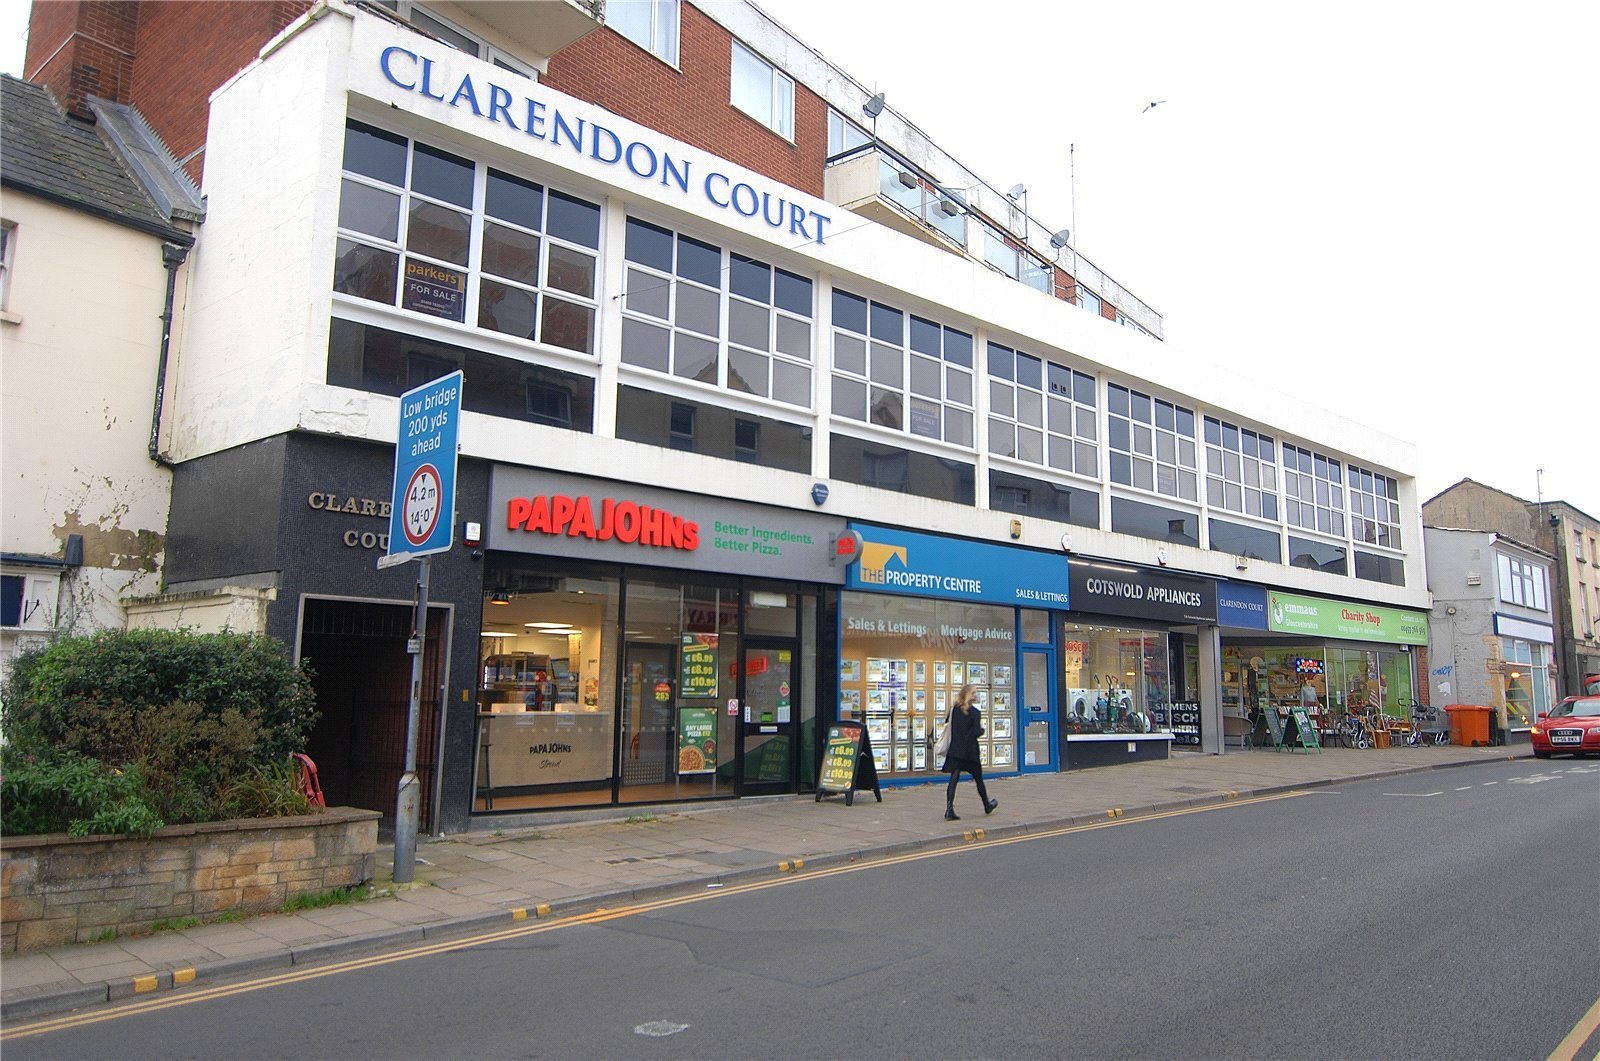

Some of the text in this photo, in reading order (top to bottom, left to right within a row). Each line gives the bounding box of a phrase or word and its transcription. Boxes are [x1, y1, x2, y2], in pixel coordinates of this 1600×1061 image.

[380, 45, 831, 246] CLARENDON COURT
[407, 263, 457, 284] parkers
[410, 283, 456, 302] FOR SALE
[403, 387, 457, 419] Low bridge
[408, 409, 448, 437] 200 yds
[411, 431, 441, 456] ahead
[410, 486, 436, 503] 4.2 m
[308, 491, 391, 518] CLARE
[508, 495, 700, 550] PAPA JOHNS
[343, 530, 389, 551] COU
[714, 521, 815, 545] Better Ingredients.
[714, 537, 783, 556] Better Pizza.
[862, 567, 982, 594] THE PROPERTY CENTRE
[1015, 588, 1068, 603] SALES & LETTINGS
[1086, 577, 1201, 607] COTSWOLD APPLIANCES
[1219, 598, 1264, 612] CLARENDON COURT
[1285, 602, 1318, 617] emmaus
[848, 617, 927, 637] Sales & Lettings
[1341, 608, 1381, 627] Charity Shop
[940, 623, 1013, 641] Mortgage Advice
[691, 651, 714, 663] £6.99
[691, 664, 713, 675] £8.99
[690, 676, 716, 687] £10.99
[1155, 703, 1198, 711] SIEMENS
[1155, 712, 1199, 723] BOSCH
[529, 743, 572, 754] PAPA JOHNS
[835, 746, 854, 756] £6.99
[833, 757, 852, 767] £8.99
[830, 768, 853, 779] £10.99
